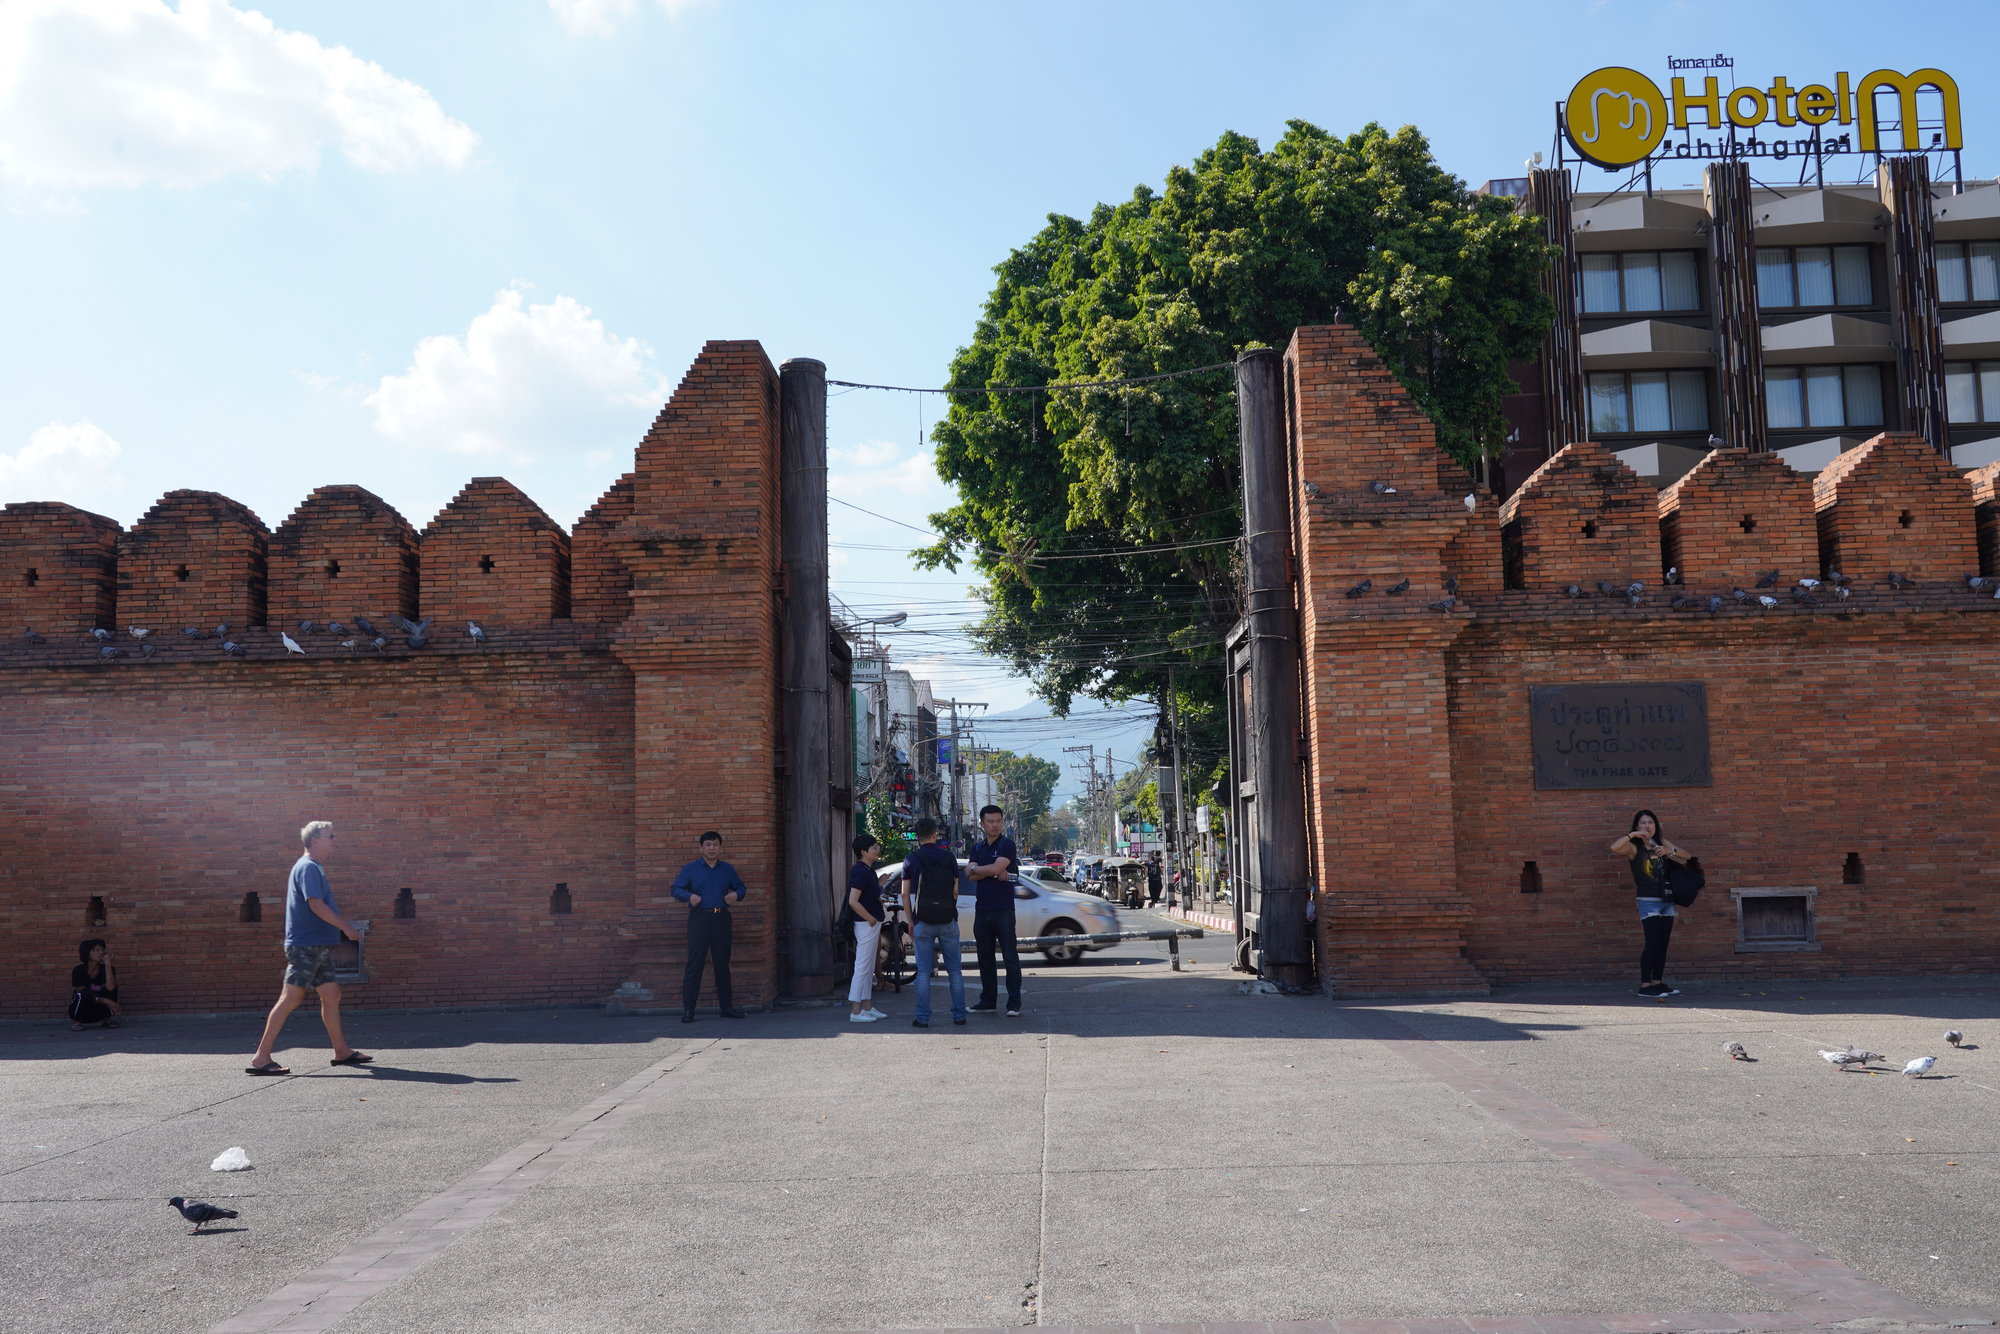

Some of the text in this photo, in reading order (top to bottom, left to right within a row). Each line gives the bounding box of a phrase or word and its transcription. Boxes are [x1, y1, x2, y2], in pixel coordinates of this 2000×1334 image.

[1667, 55, 1705, 69] โฮเทล
[1671, 71, 1852, 130] Hotel
[1676, 133, 1851, 160] chiangmai
[1550, 699, 1685, 735] ประตูท่าแพ
[1574, 766, 1669, 778] THA PHAE GATE
